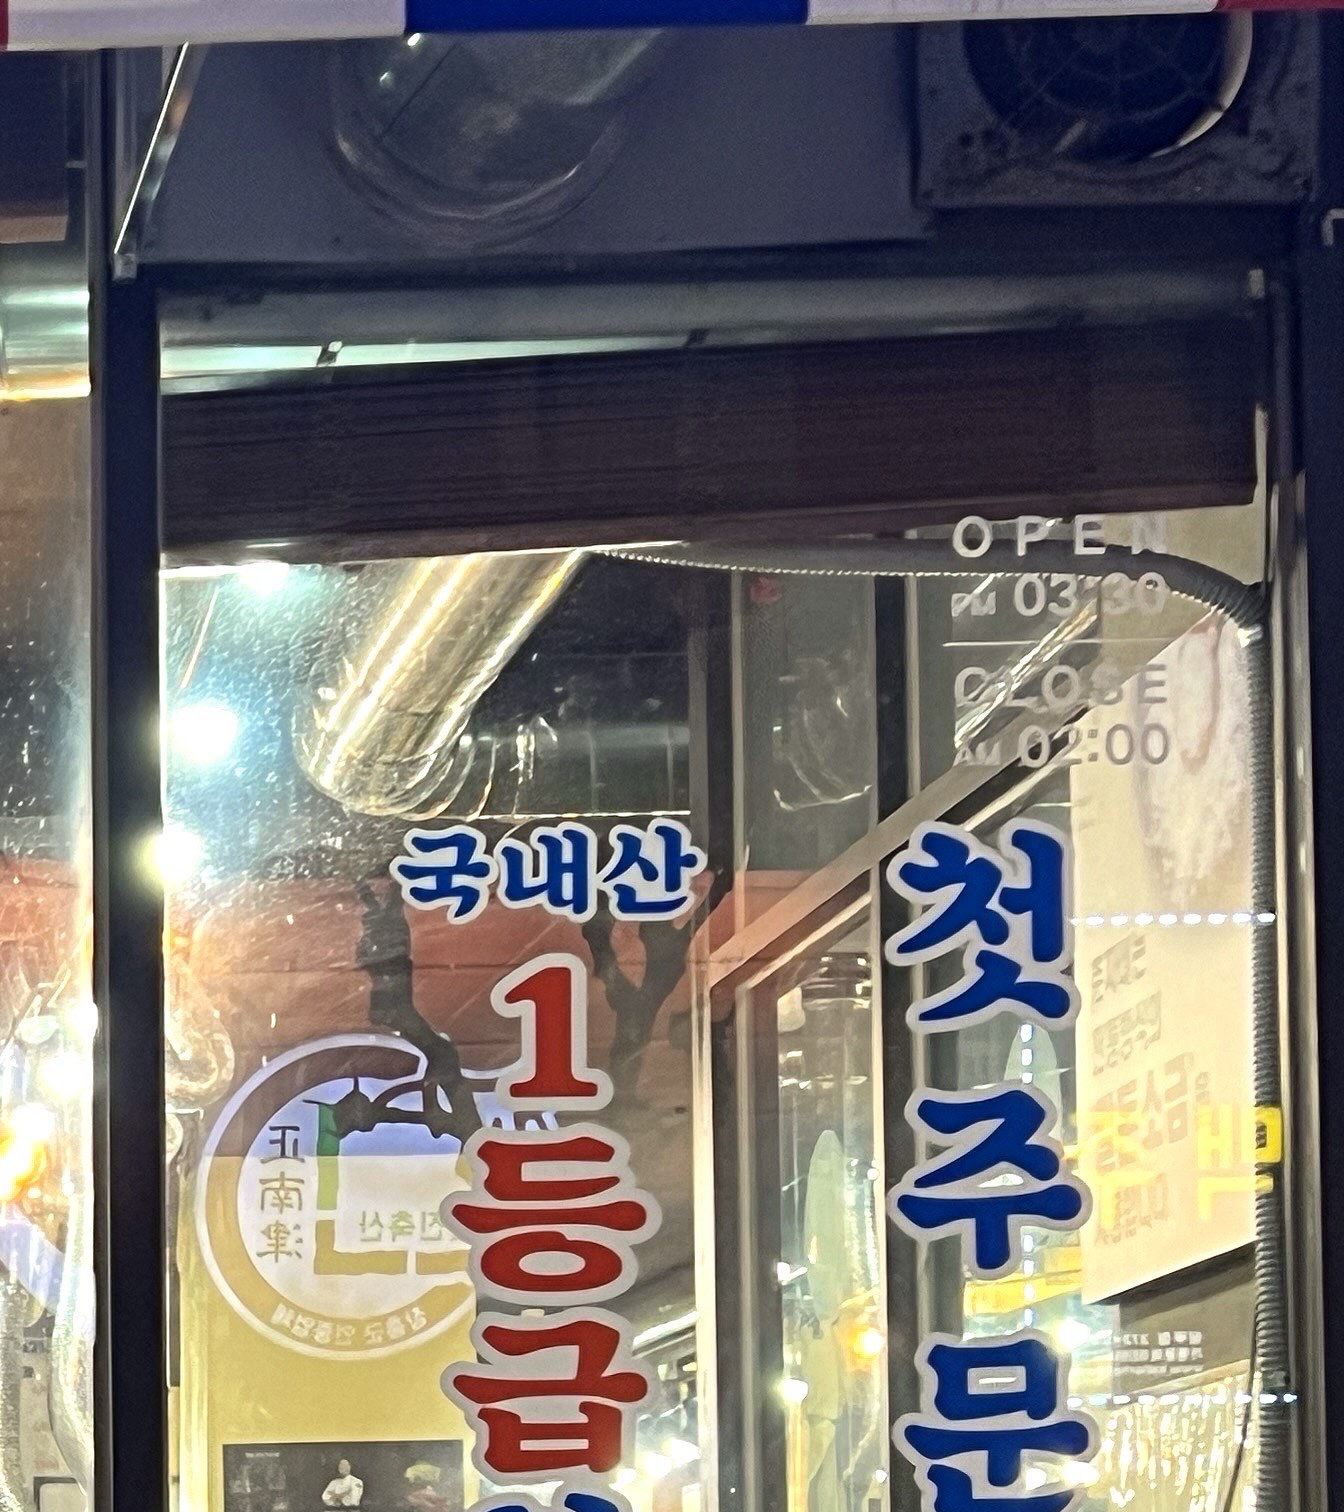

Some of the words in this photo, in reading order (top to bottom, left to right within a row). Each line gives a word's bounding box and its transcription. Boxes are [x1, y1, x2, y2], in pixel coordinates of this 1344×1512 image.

[952, 514, 1167, 558] OPEN
[1014, 571, 1170, 617] 0330
[1018, 722, 1170, 769] 02:00
[396, 825, 699, 918] 국내산
